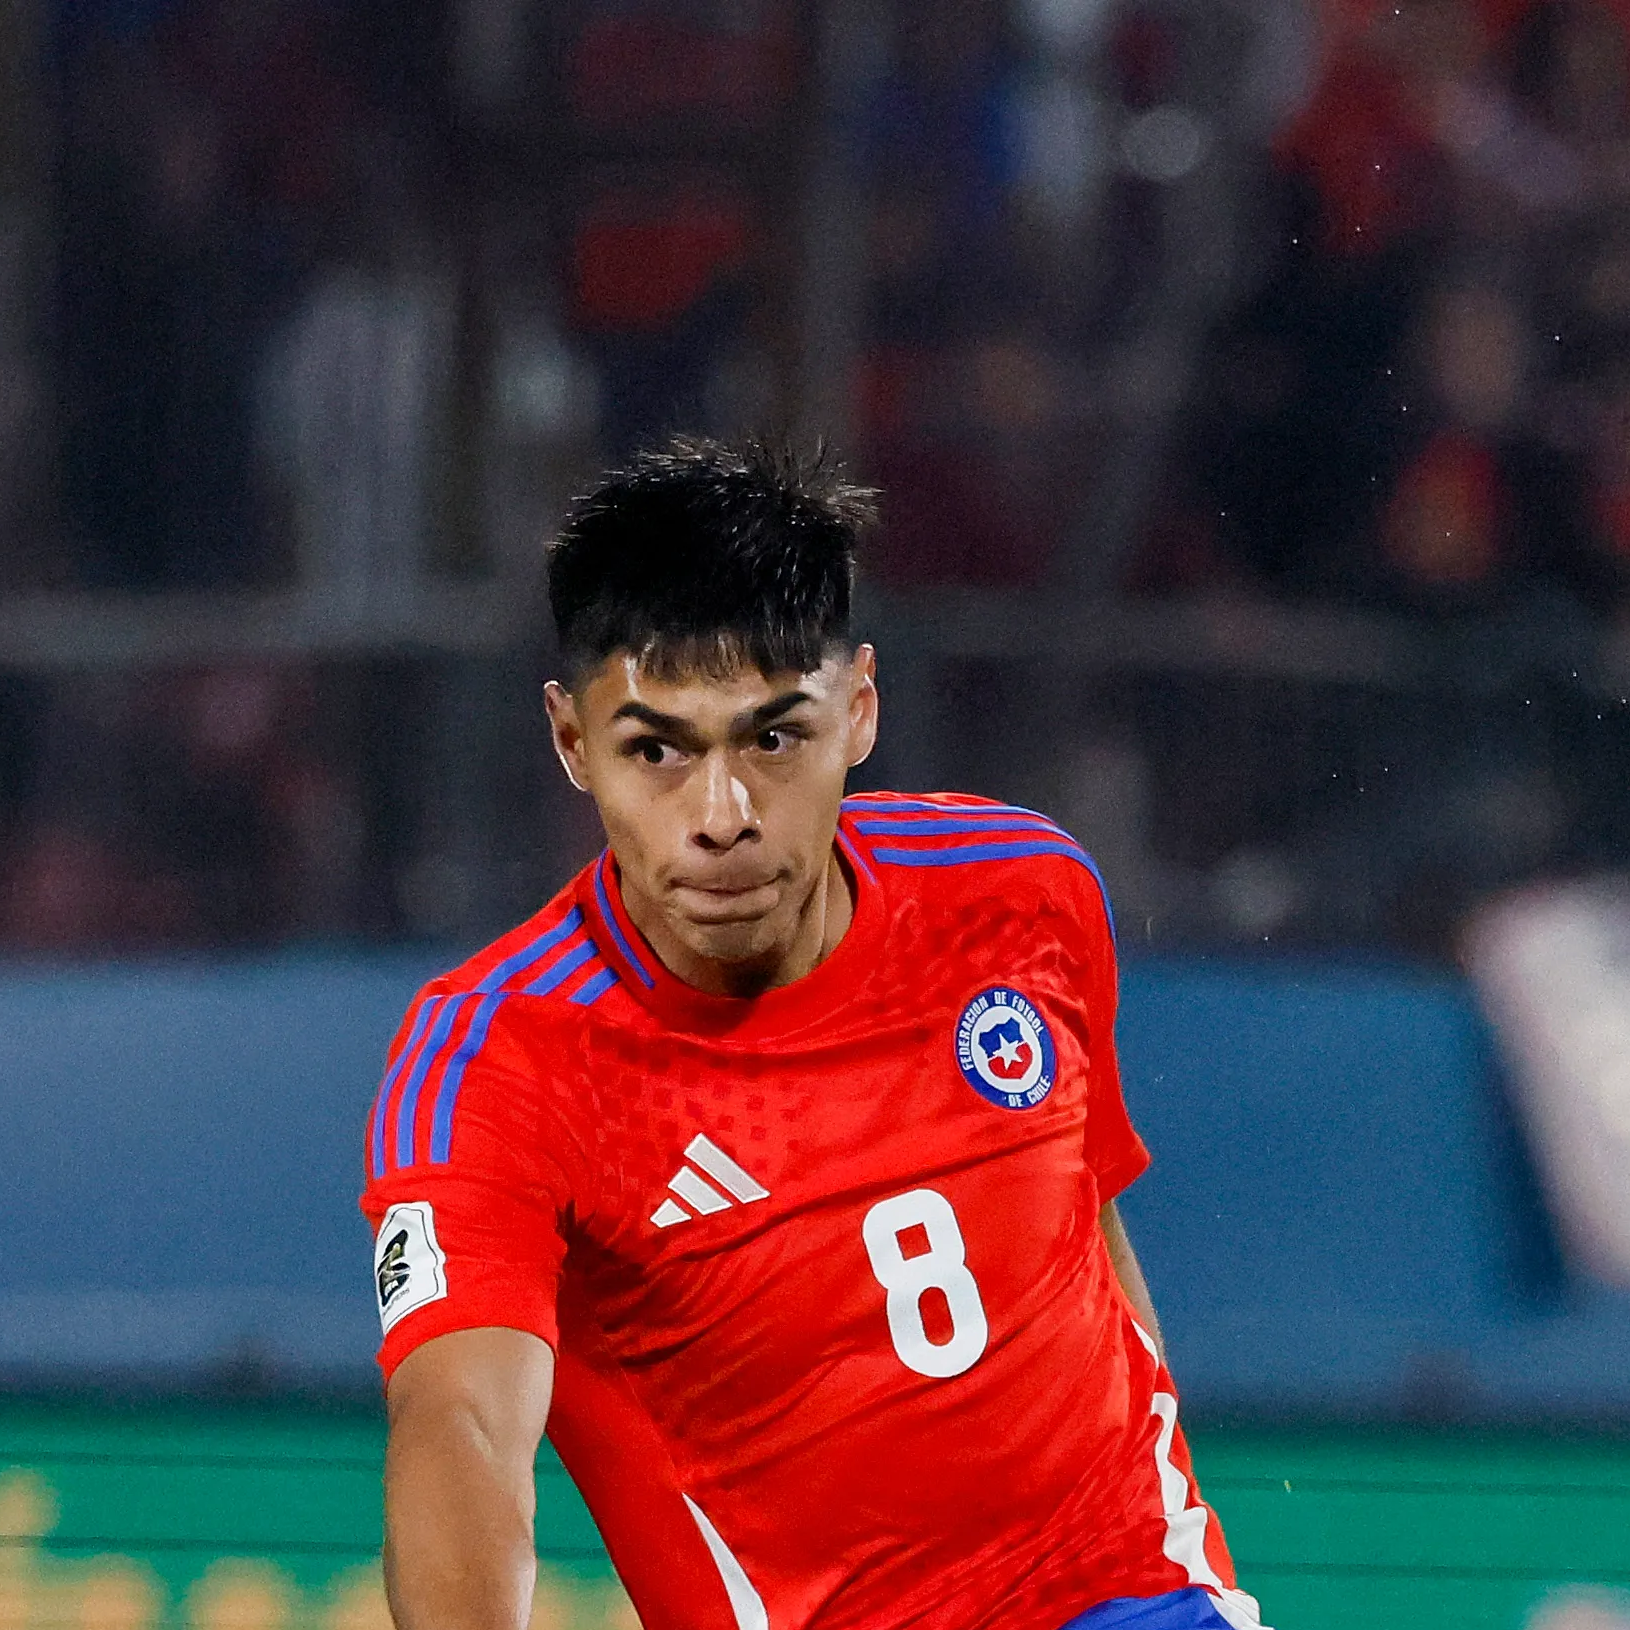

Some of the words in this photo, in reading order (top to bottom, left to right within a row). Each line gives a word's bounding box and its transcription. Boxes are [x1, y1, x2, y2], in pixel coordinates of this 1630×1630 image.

[993, 991, 1007, 1006] DE
[1008, 1094, 1023, 1107] DE
[1026, 1075, 1051, 1105] CHILE
[862, 1188, 988, 1378] 8
